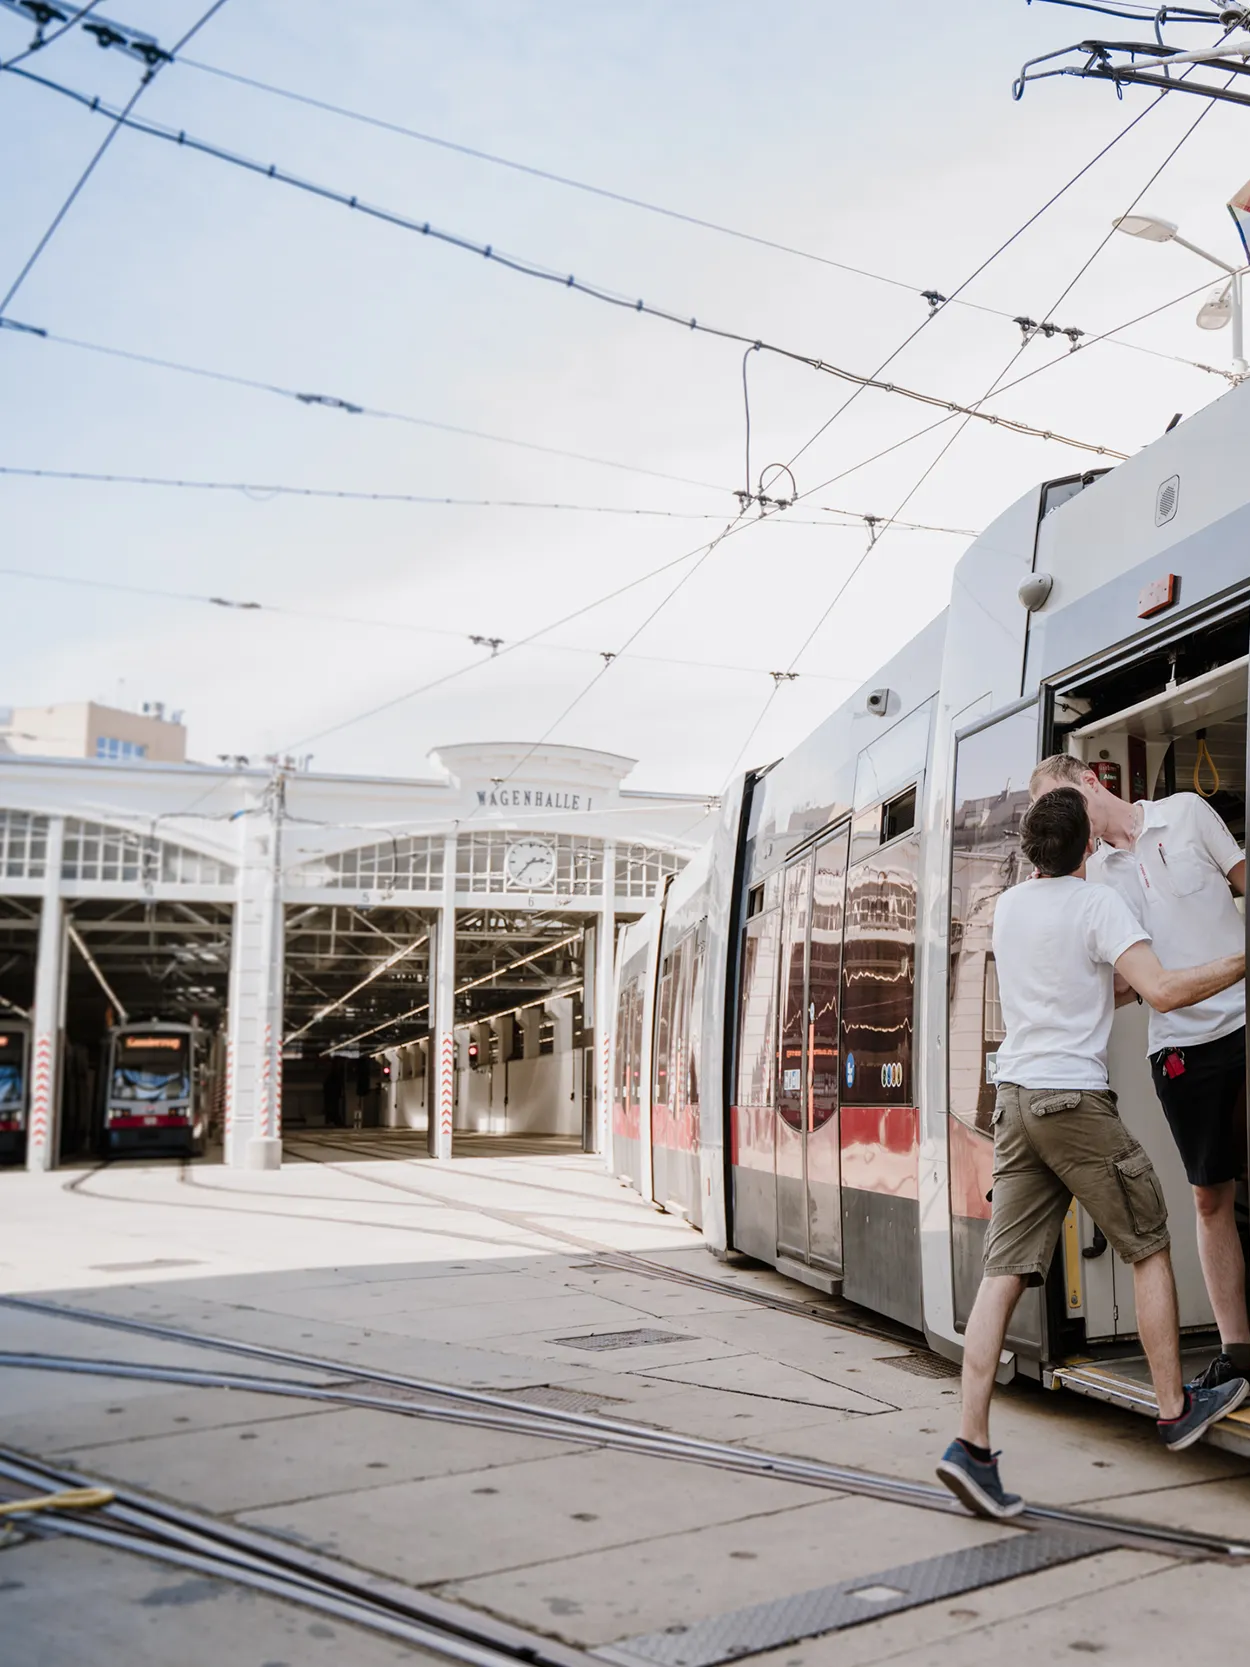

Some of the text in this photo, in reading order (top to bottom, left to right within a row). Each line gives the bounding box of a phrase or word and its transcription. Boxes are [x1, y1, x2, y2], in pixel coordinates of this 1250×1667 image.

[476, 790, 580, 810] WAGENHALLE
[362, 891, 371, 903] 5
[528, 896, 535, 907] 6
